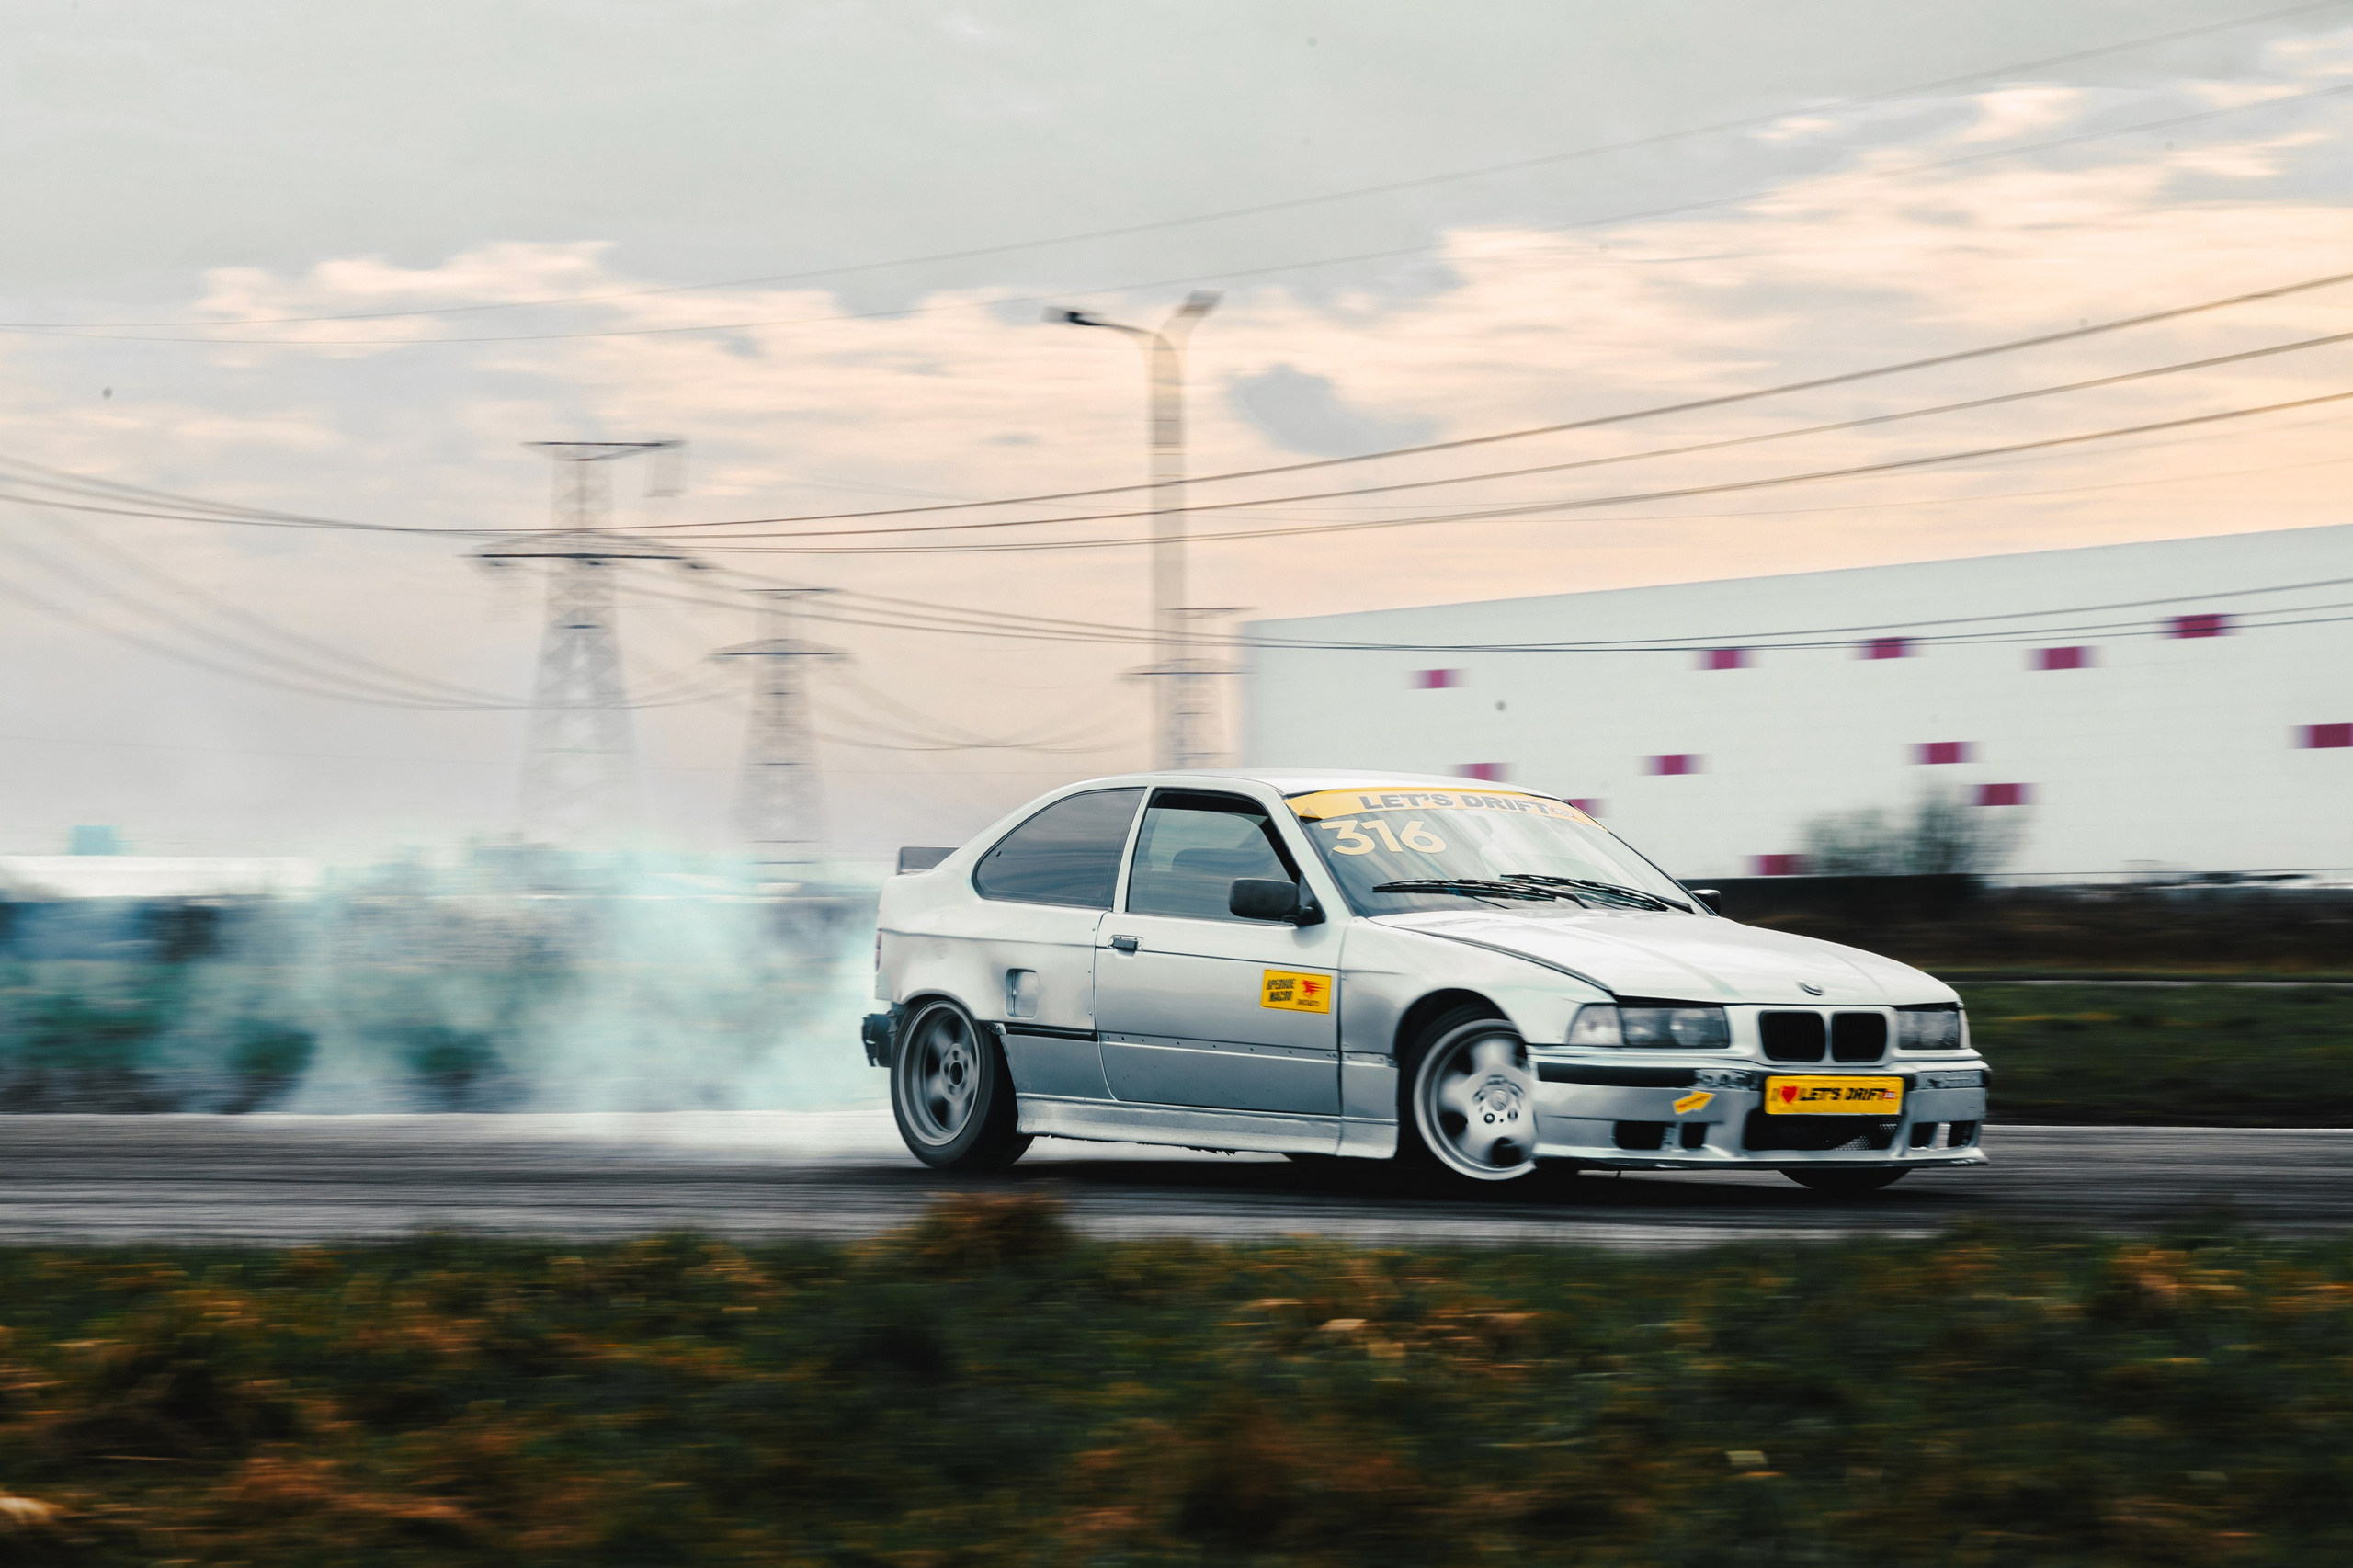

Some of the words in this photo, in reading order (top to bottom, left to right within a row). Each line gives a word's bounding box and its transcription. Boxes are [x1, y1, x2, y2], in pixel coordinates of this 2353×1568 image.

[1358, 793, 1454, 810] LET'S
[1319, 819, 1447, 856] 316
[1798, 1087, 1841, 1101] LET'S
